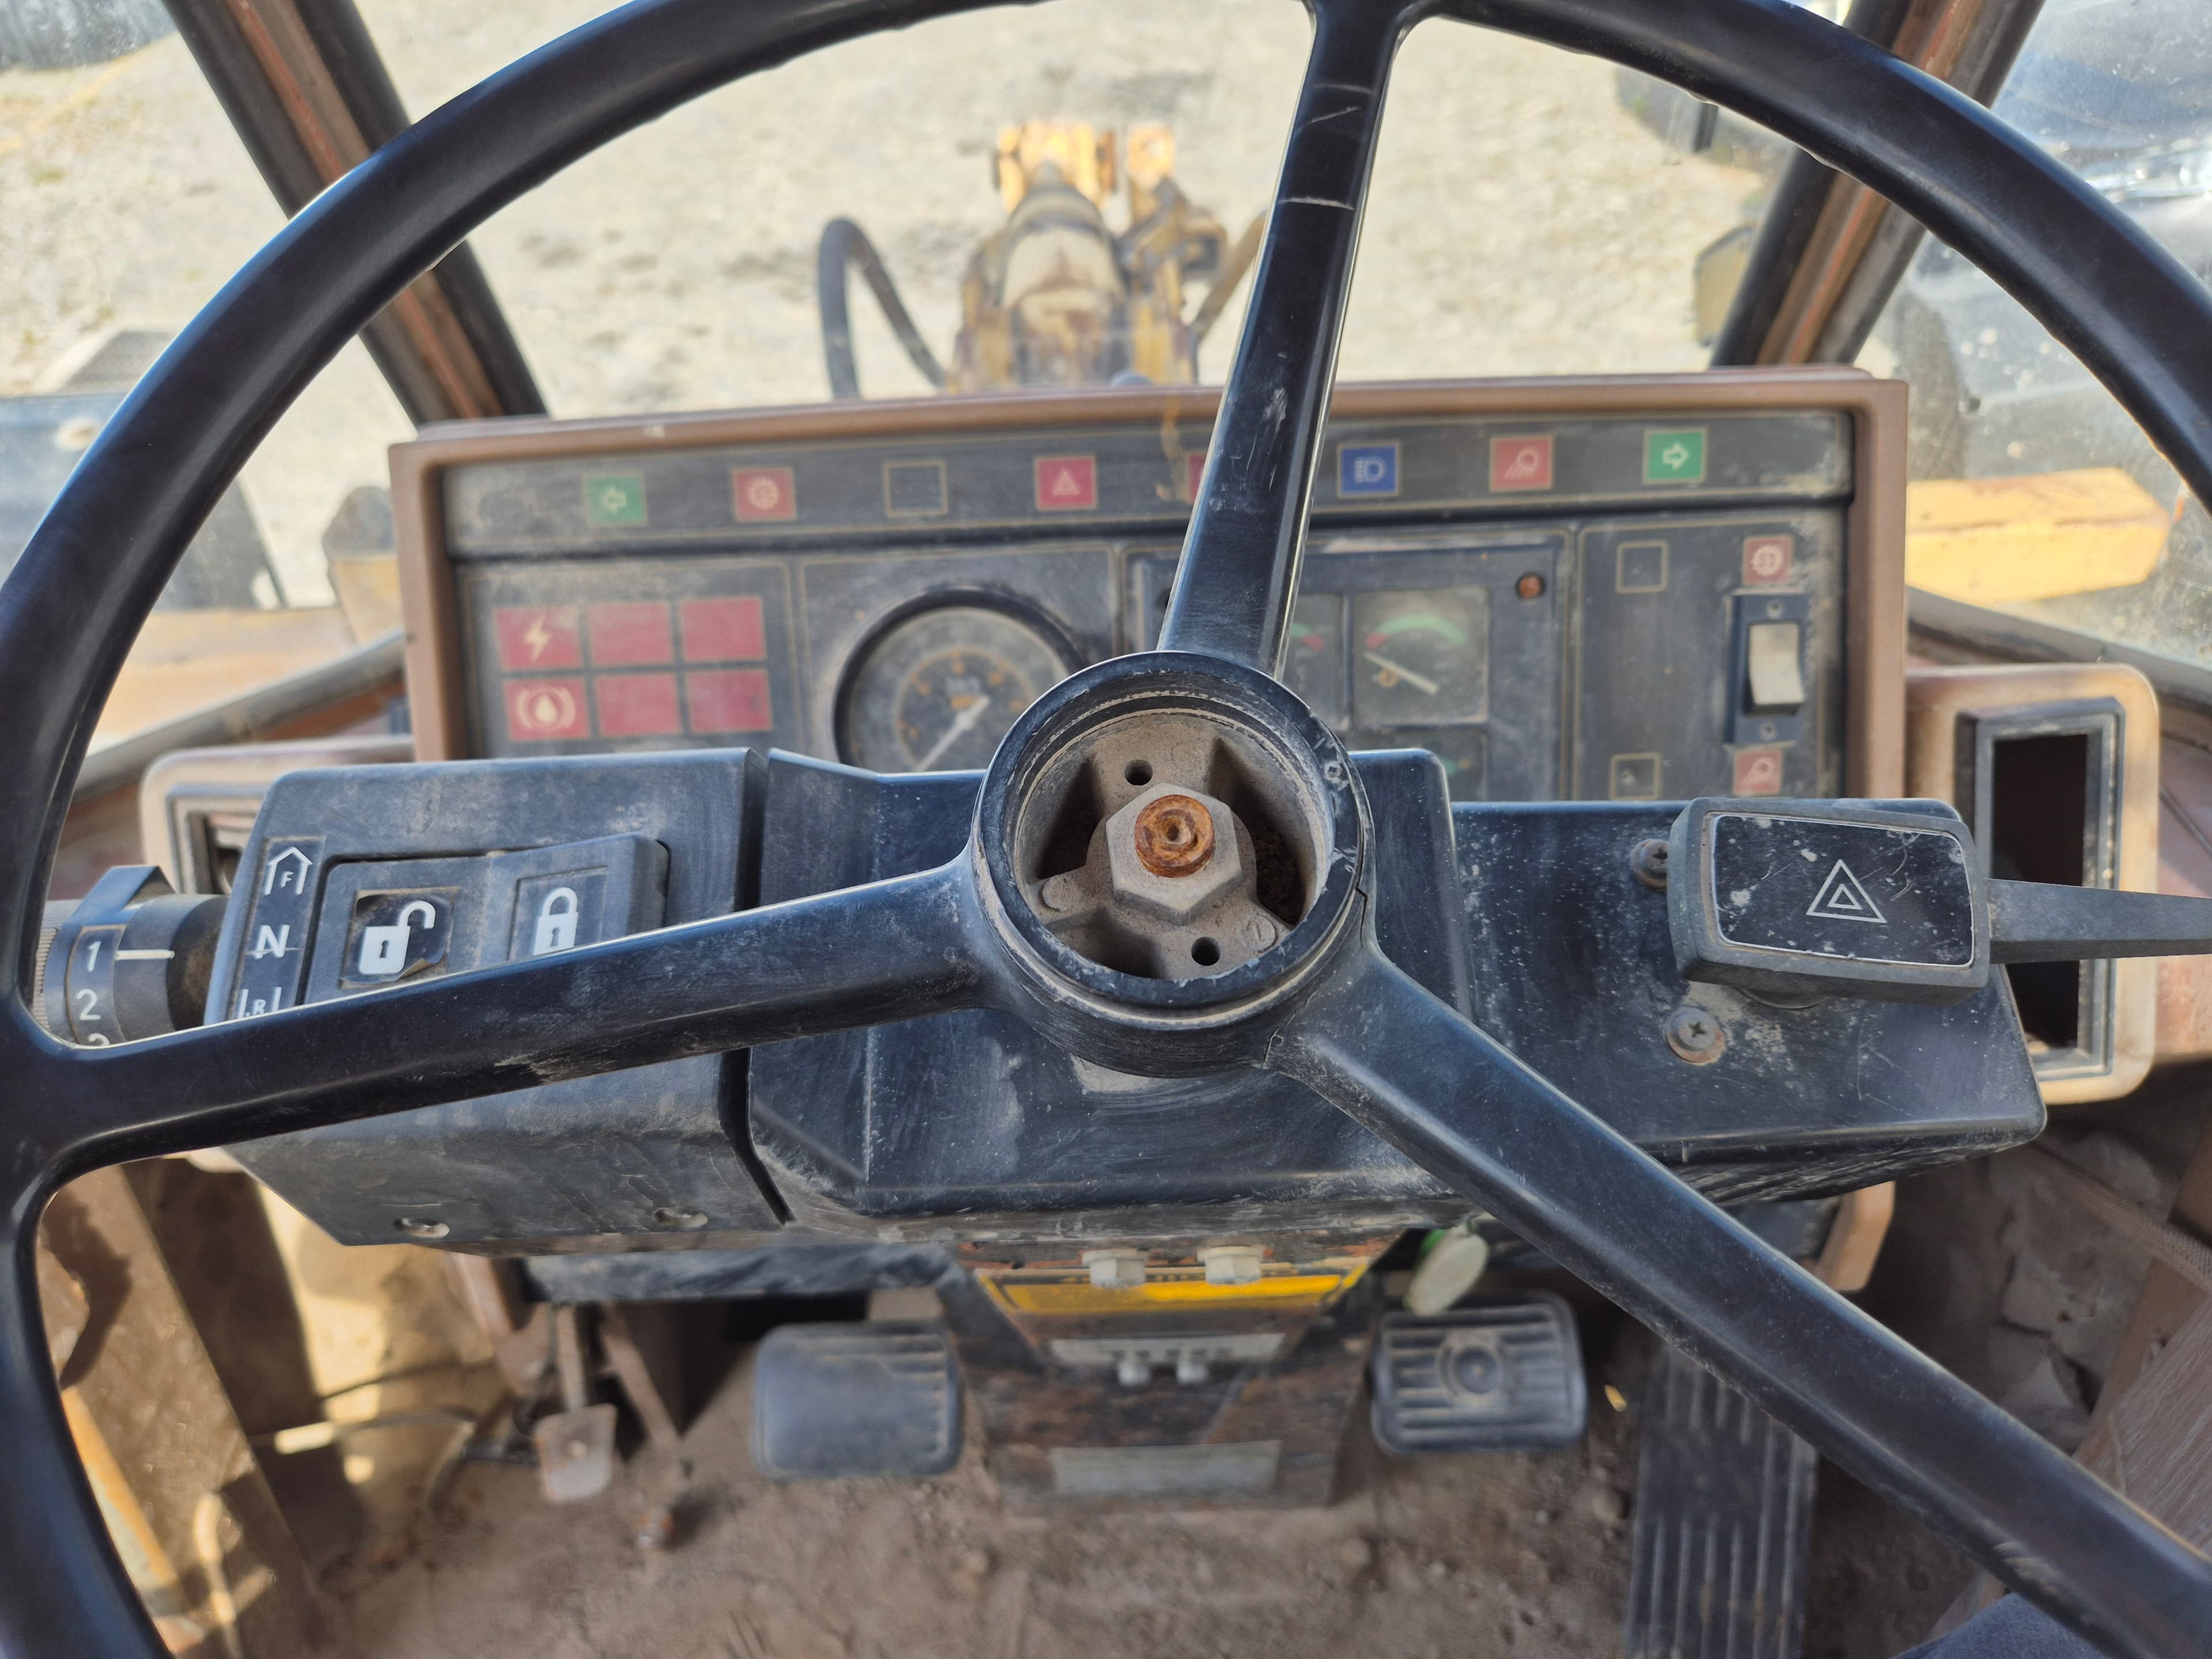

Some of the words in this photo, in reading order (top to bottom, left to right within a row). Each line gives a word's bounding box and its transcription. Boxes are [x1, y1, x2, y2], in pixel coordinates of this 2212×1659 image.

[280, 870, 294, 888] F
[88, 940, 101, 972] 1
[255, 924, 290, 960] N
[76, 988, 101, 1021] 2
[253, 999, 267, 1016] R
